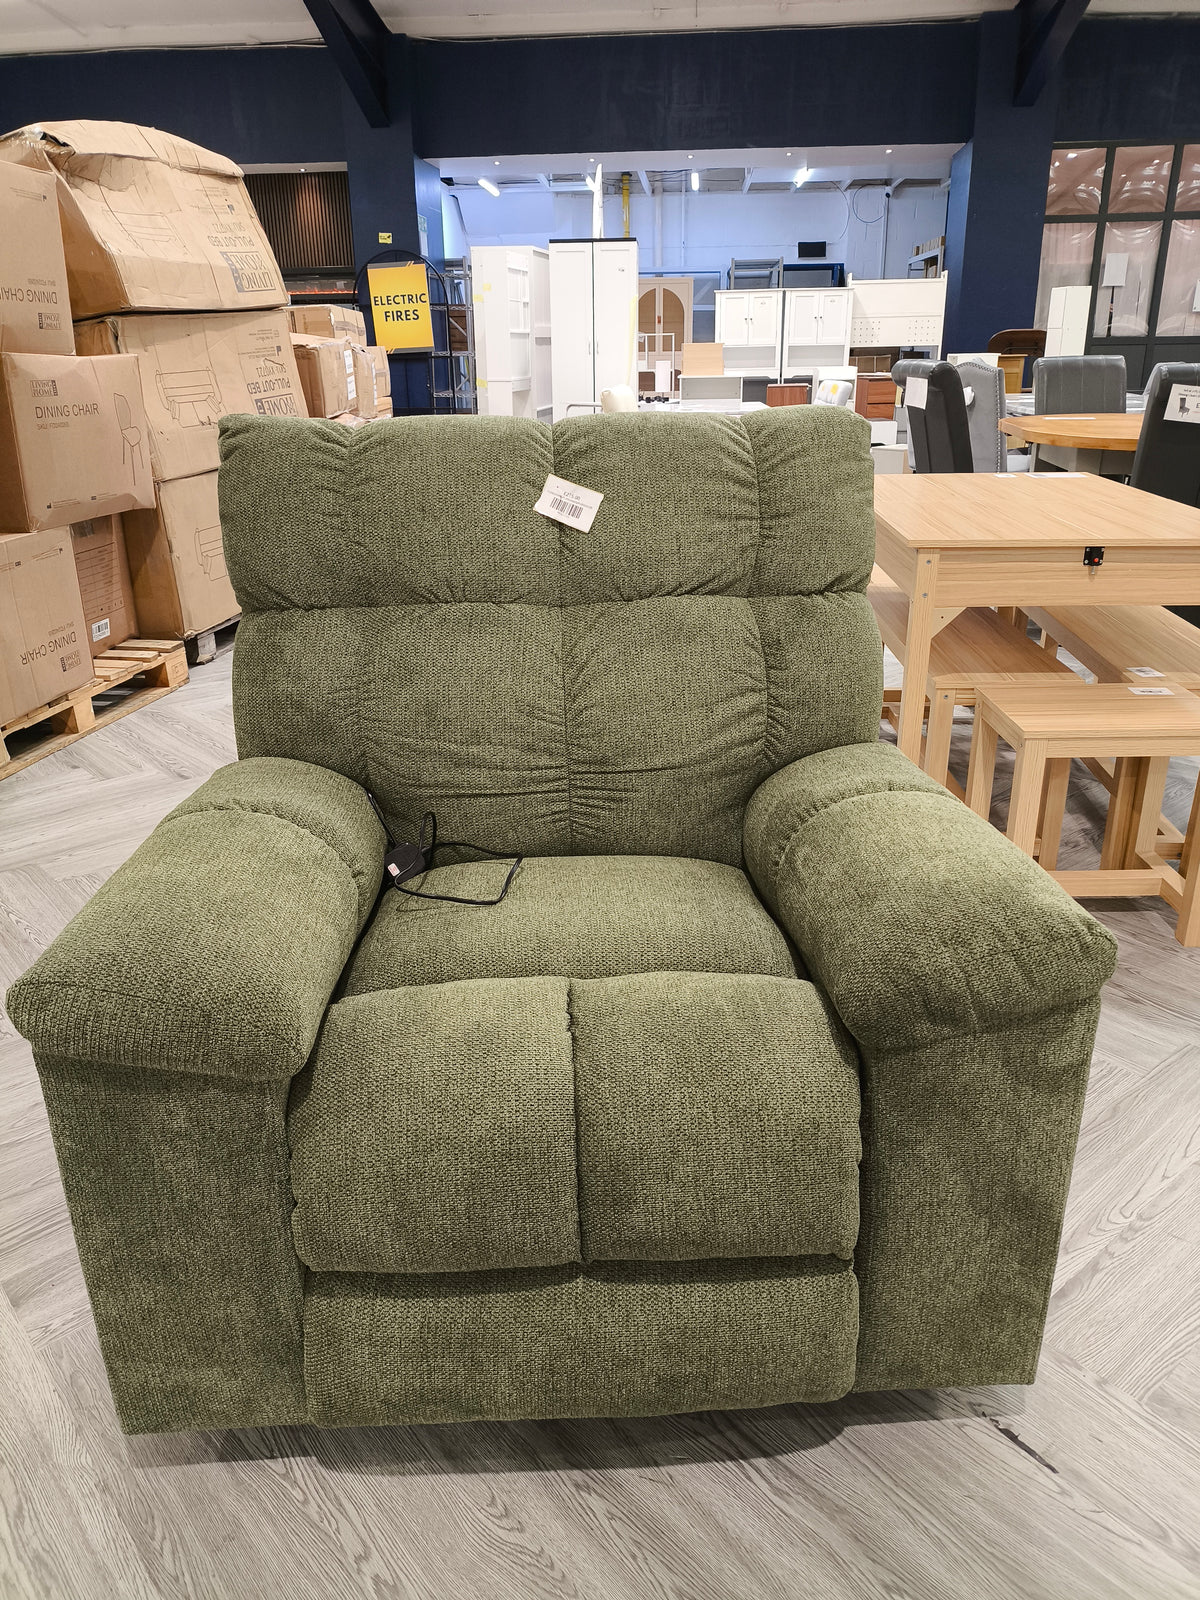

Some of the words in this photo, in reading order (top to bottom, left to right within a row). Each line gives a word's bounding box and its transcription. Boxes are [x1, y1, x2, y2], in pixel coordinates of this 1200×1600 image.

[241, 271, 274, 290] LIVING
[26, 289, 57, 304] DINING
[373, 293, 427, 306] ELECTRIC
[384, 309, 419, 322] FIRES
[247, 381, 261, 394] BED
[263, 377, 290, 393] PULL-OUT
[35, 404, 70, 418] DINING
[72, 403, 99, 416] CHAIR
[48, 631, 76, 652] DINING
[20, 644, 46, 665] CHAIR
